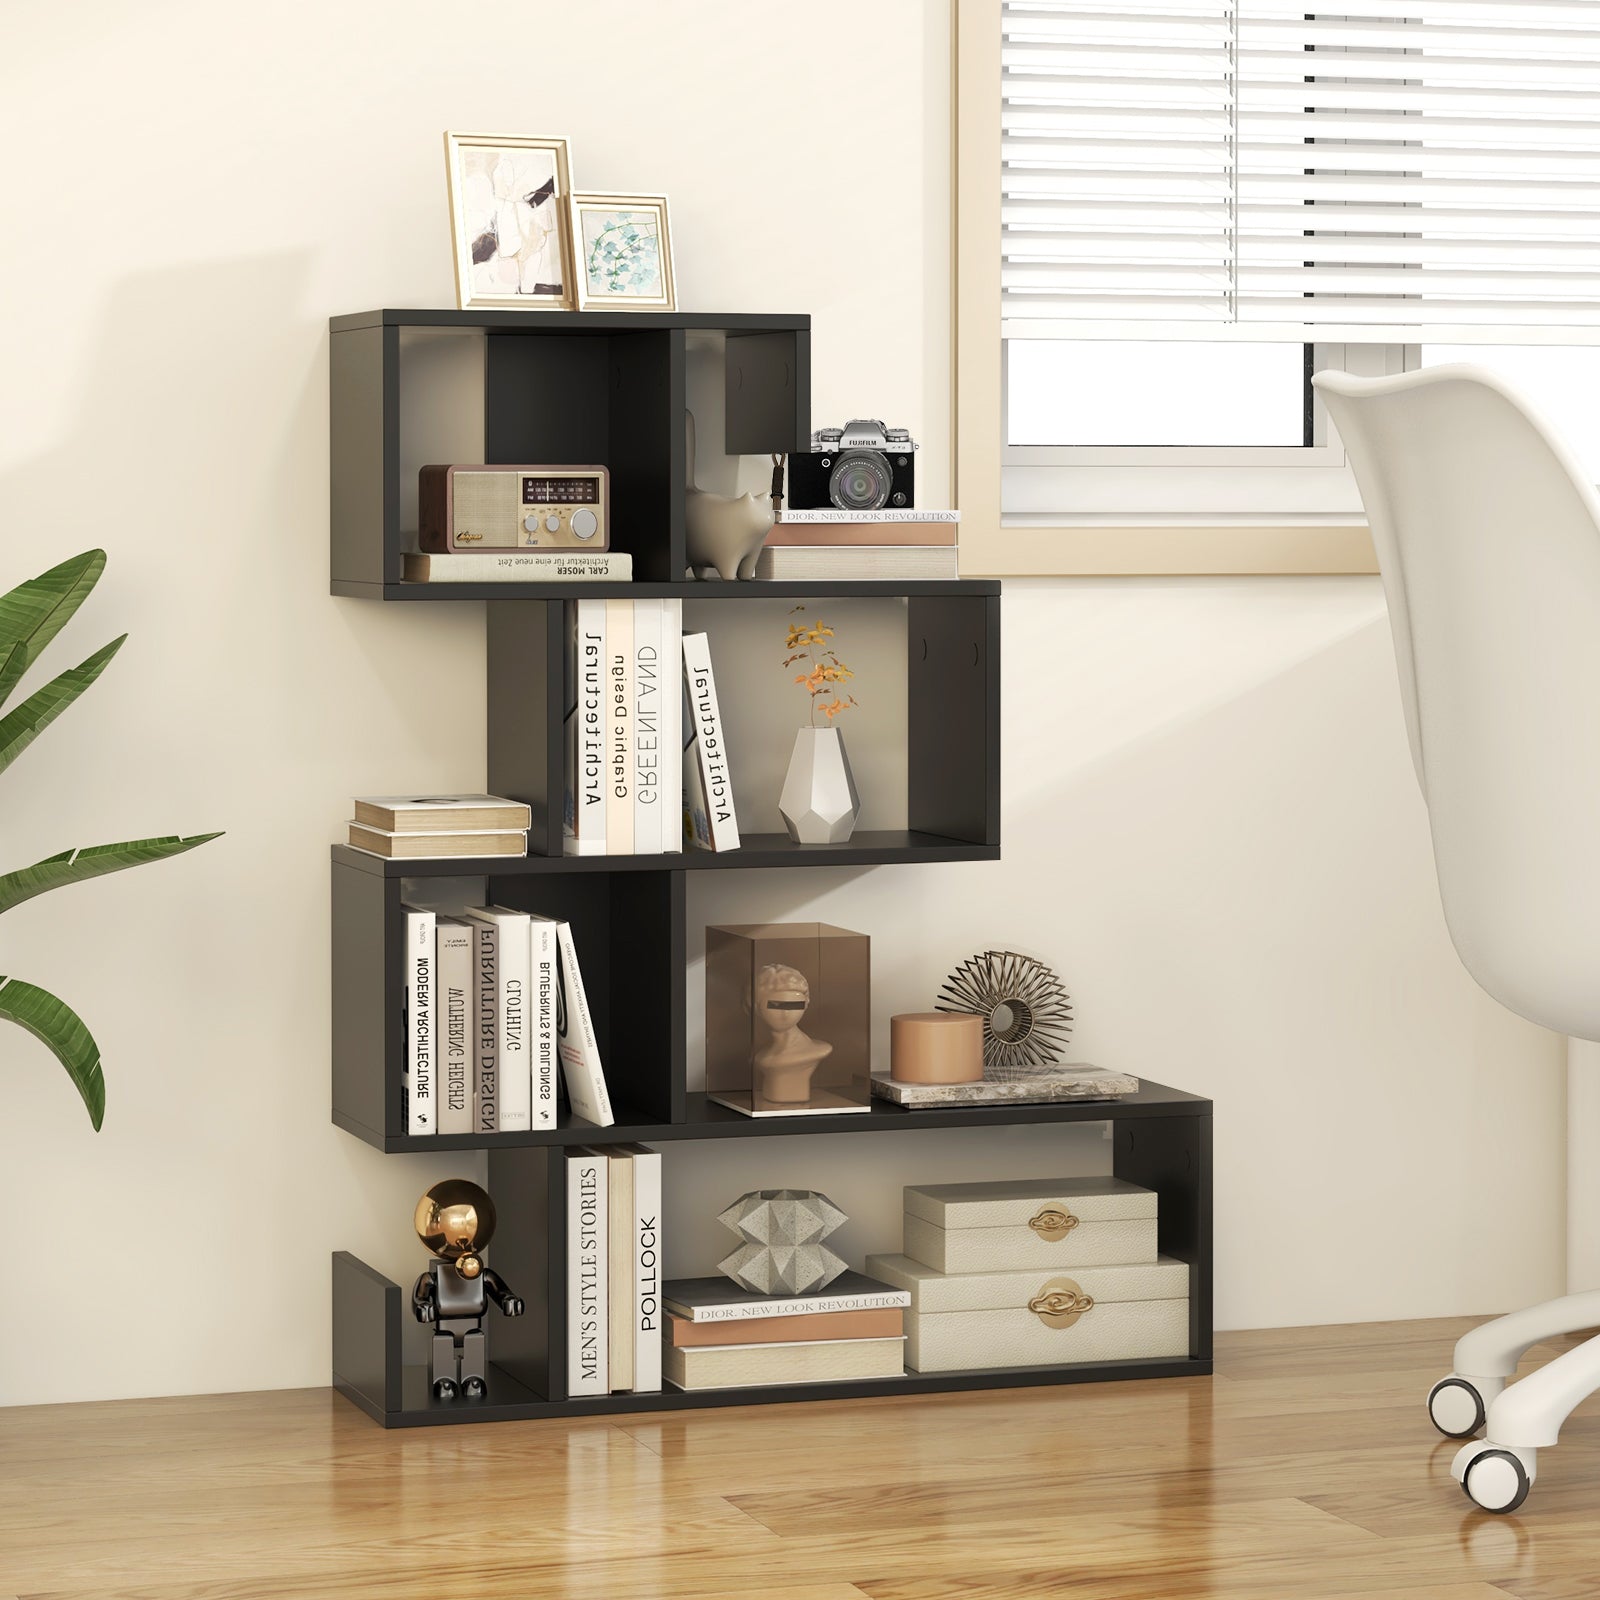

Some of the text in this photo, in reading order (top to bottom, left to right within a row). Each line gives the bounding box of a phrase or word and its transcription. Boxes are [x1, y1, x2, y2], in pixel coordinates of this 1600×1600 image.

[821, 513, 847, 521] NEW
[850, 513, 881, 521] LOOK
[884, 512, 957, 521] REVOLUTION
[498, 558, 513, 567] Zeit
[535, 558, 552, 566] eine
[553, 558, 565, 567] für
[567, 558, 609, 567] Architektur
[557, 567, 609, 575] CARL MOSER
[581, 1167, 597, 1380] MEN'S STYLE STORIES
[640, 1216, 657, 1331] POLLOCK
[742, 1306, 773, 1317] NEW
[777, 1303, 814, 1314] LOOK
[818, 1296, 905, 1311] REVOLUTION
